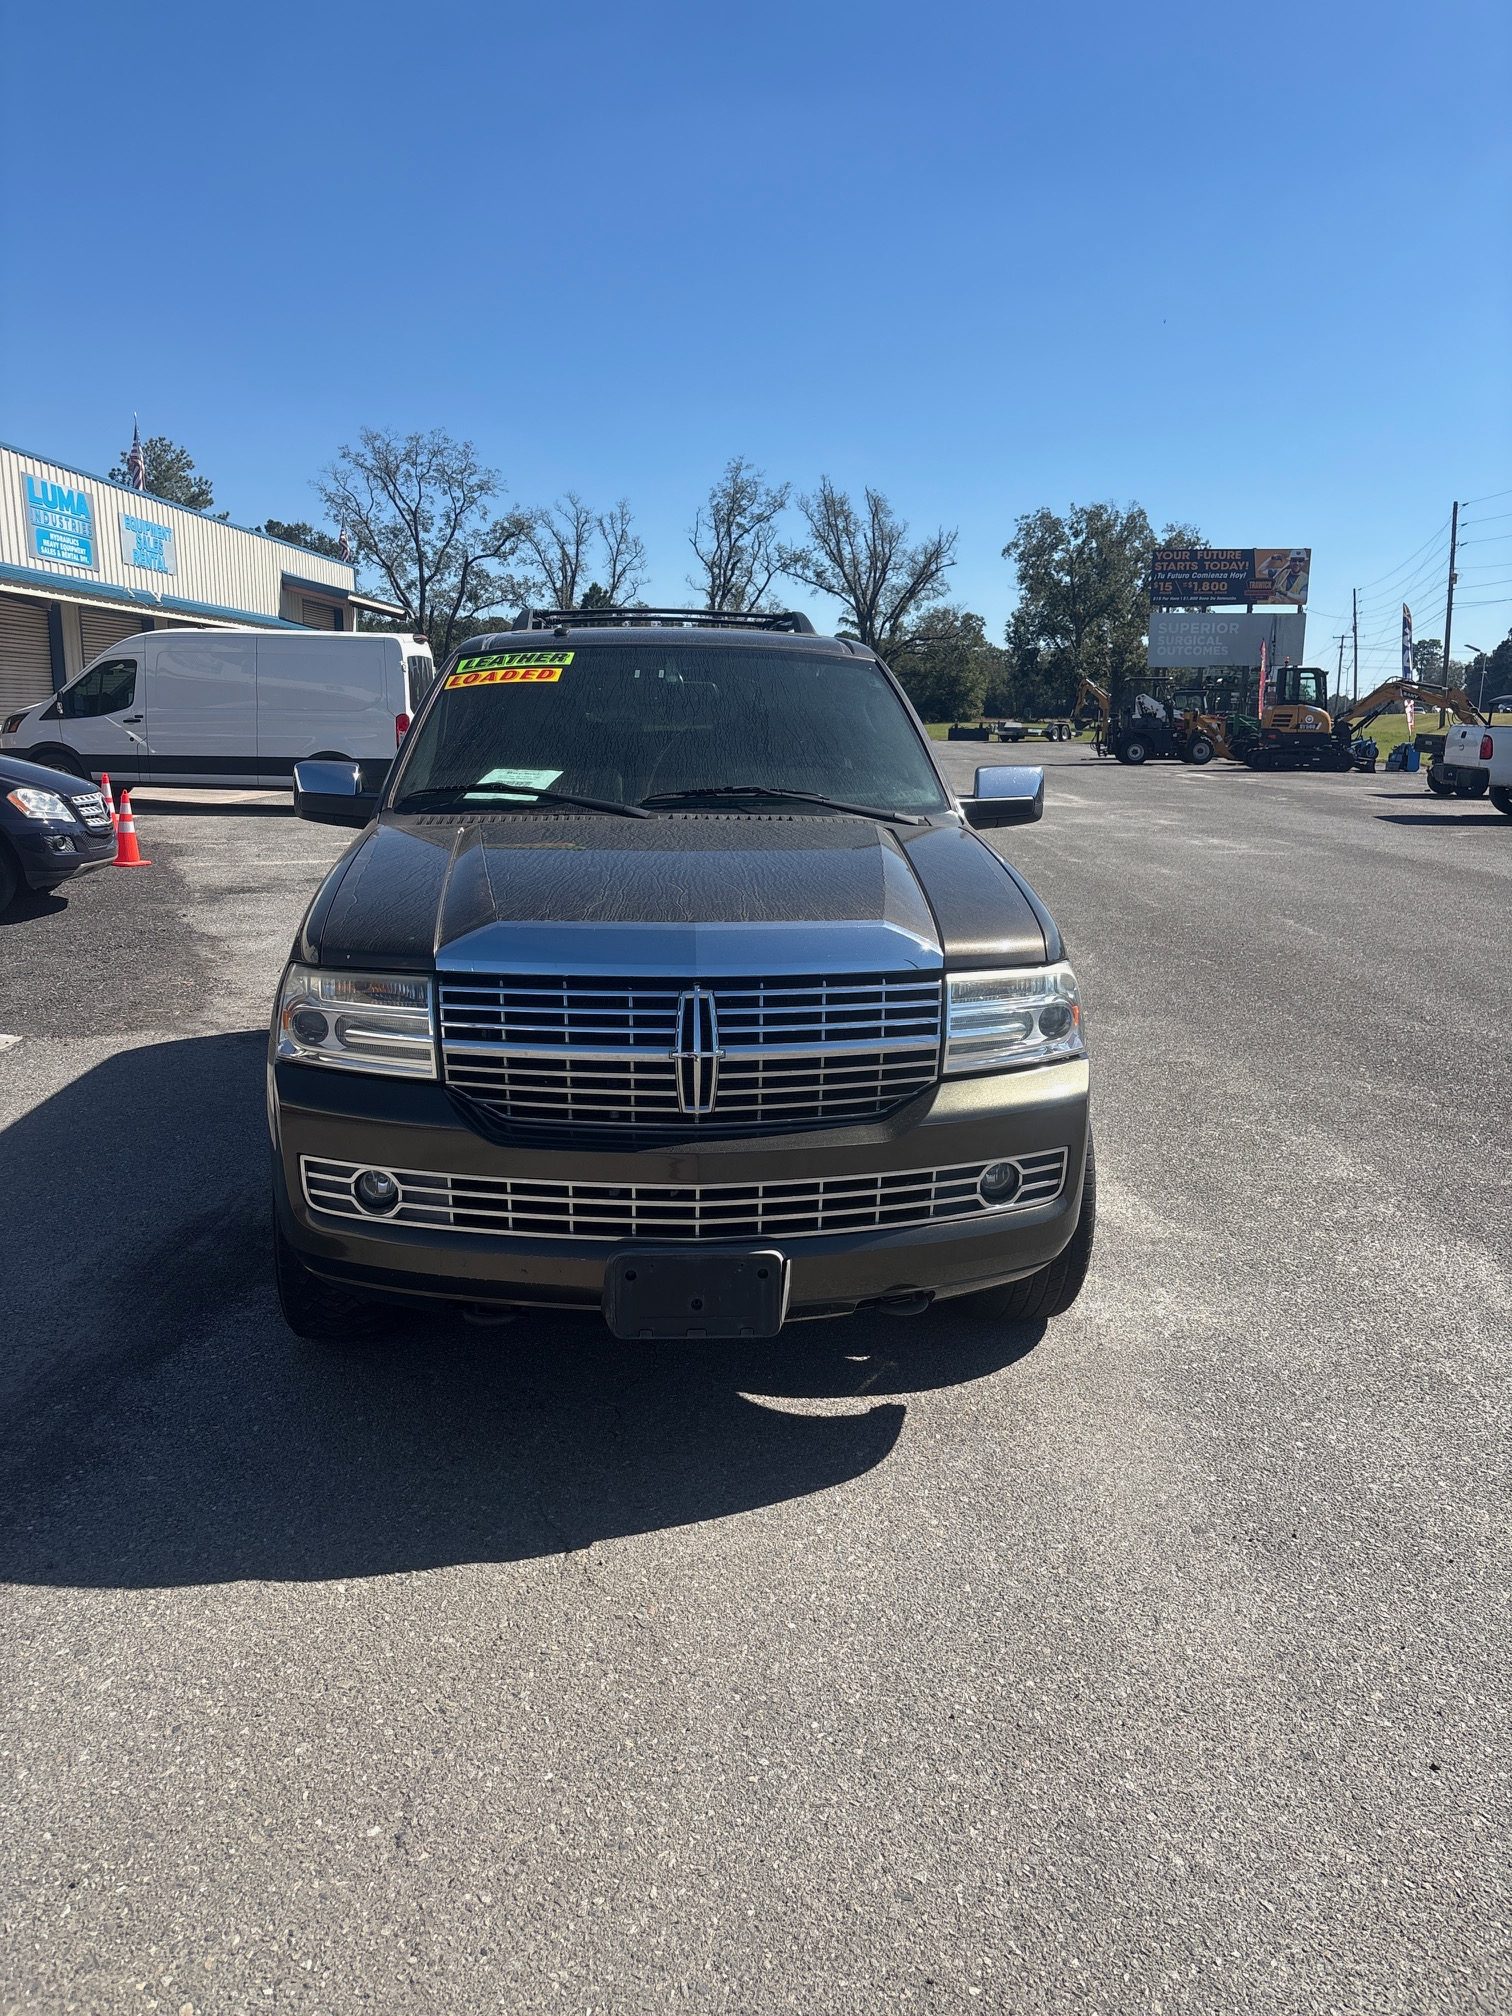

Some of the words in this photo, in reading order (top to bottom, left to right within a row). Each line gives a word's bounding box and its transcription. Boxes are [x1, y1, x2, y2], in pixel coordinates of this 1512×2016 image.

[26, 476, 90, 520] LUMA
[29, 507, 93, 537] INDUSTRIES
[124, 514, 172, 542] EQUIPMENT
[135, 533, 164, 556] SALES
[132, 549, 168, 574] RENTAL
[1154, 551, 1190, 560] YOUR
[1197, 551, 1242, 560] FUTURE
[1154, 562, 1198, 571] STARTS
[1203, 561, 1250, 570] TODAY!
[1166, 572, 1190, 580] Futuro
[1191, 571, 1228, 580] Comienza
[1229, 571, 1247, 581] Hoy!
[1153, 581, 1173, 591] $15
[1158, 622, 1240, 635] SUPERIOR
[1157, 635, 1223, 646] SURGICAL
[1156, 646, 1228, 656] OUTCOMES
[461, 653, 569, 670] LEATHER
[448, 669, 556, 687] LOADED
